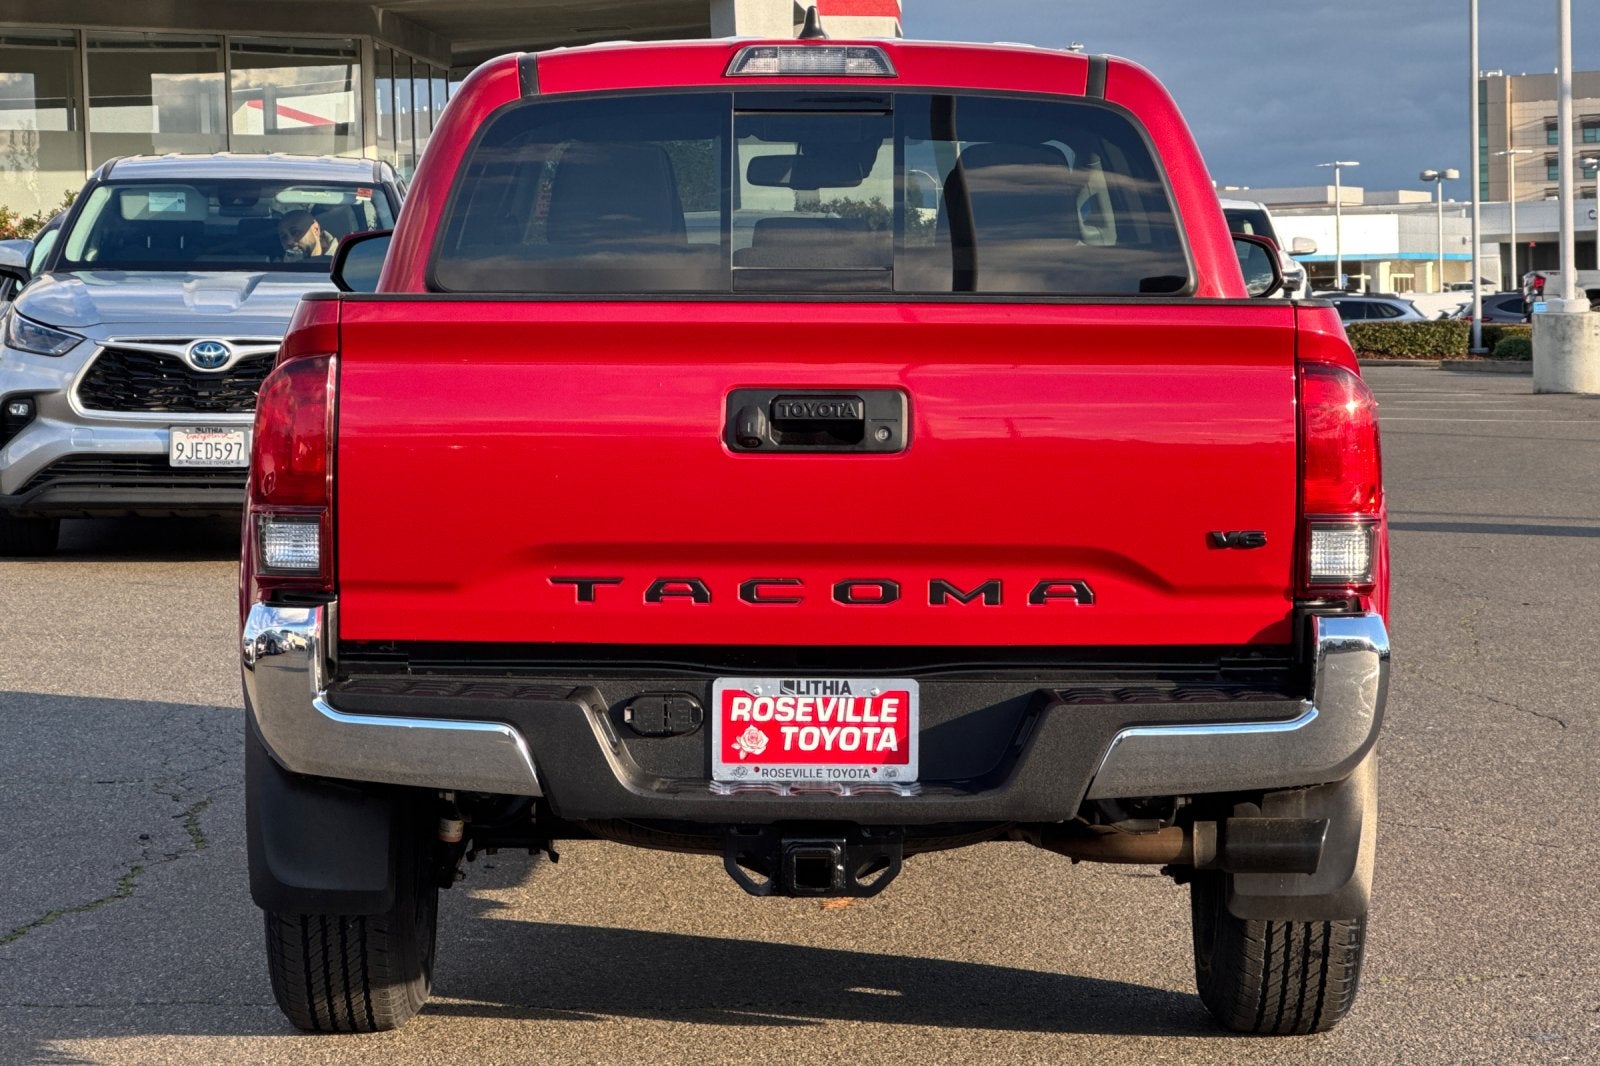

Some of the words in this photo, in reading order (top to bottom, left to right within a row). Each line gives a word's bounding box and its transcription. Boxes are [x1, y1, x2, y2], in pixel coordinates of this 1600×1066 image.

[779, 402, 857, 418] TOYOTA
[176, 442, 242, 460] 9JED597
[1210, 529, 1267, 549] V6
[546, 576, 1095, 606] TACOMA
[796, 680, 852, 696] LITHIA
[730, 696, 899, 723] ROSEVILLE
[780, 726, 898, 752] TOYOTA
[761, 767, 823, 779] ROSEVILLE
[827, 768, 870, 779] TOYOTA
